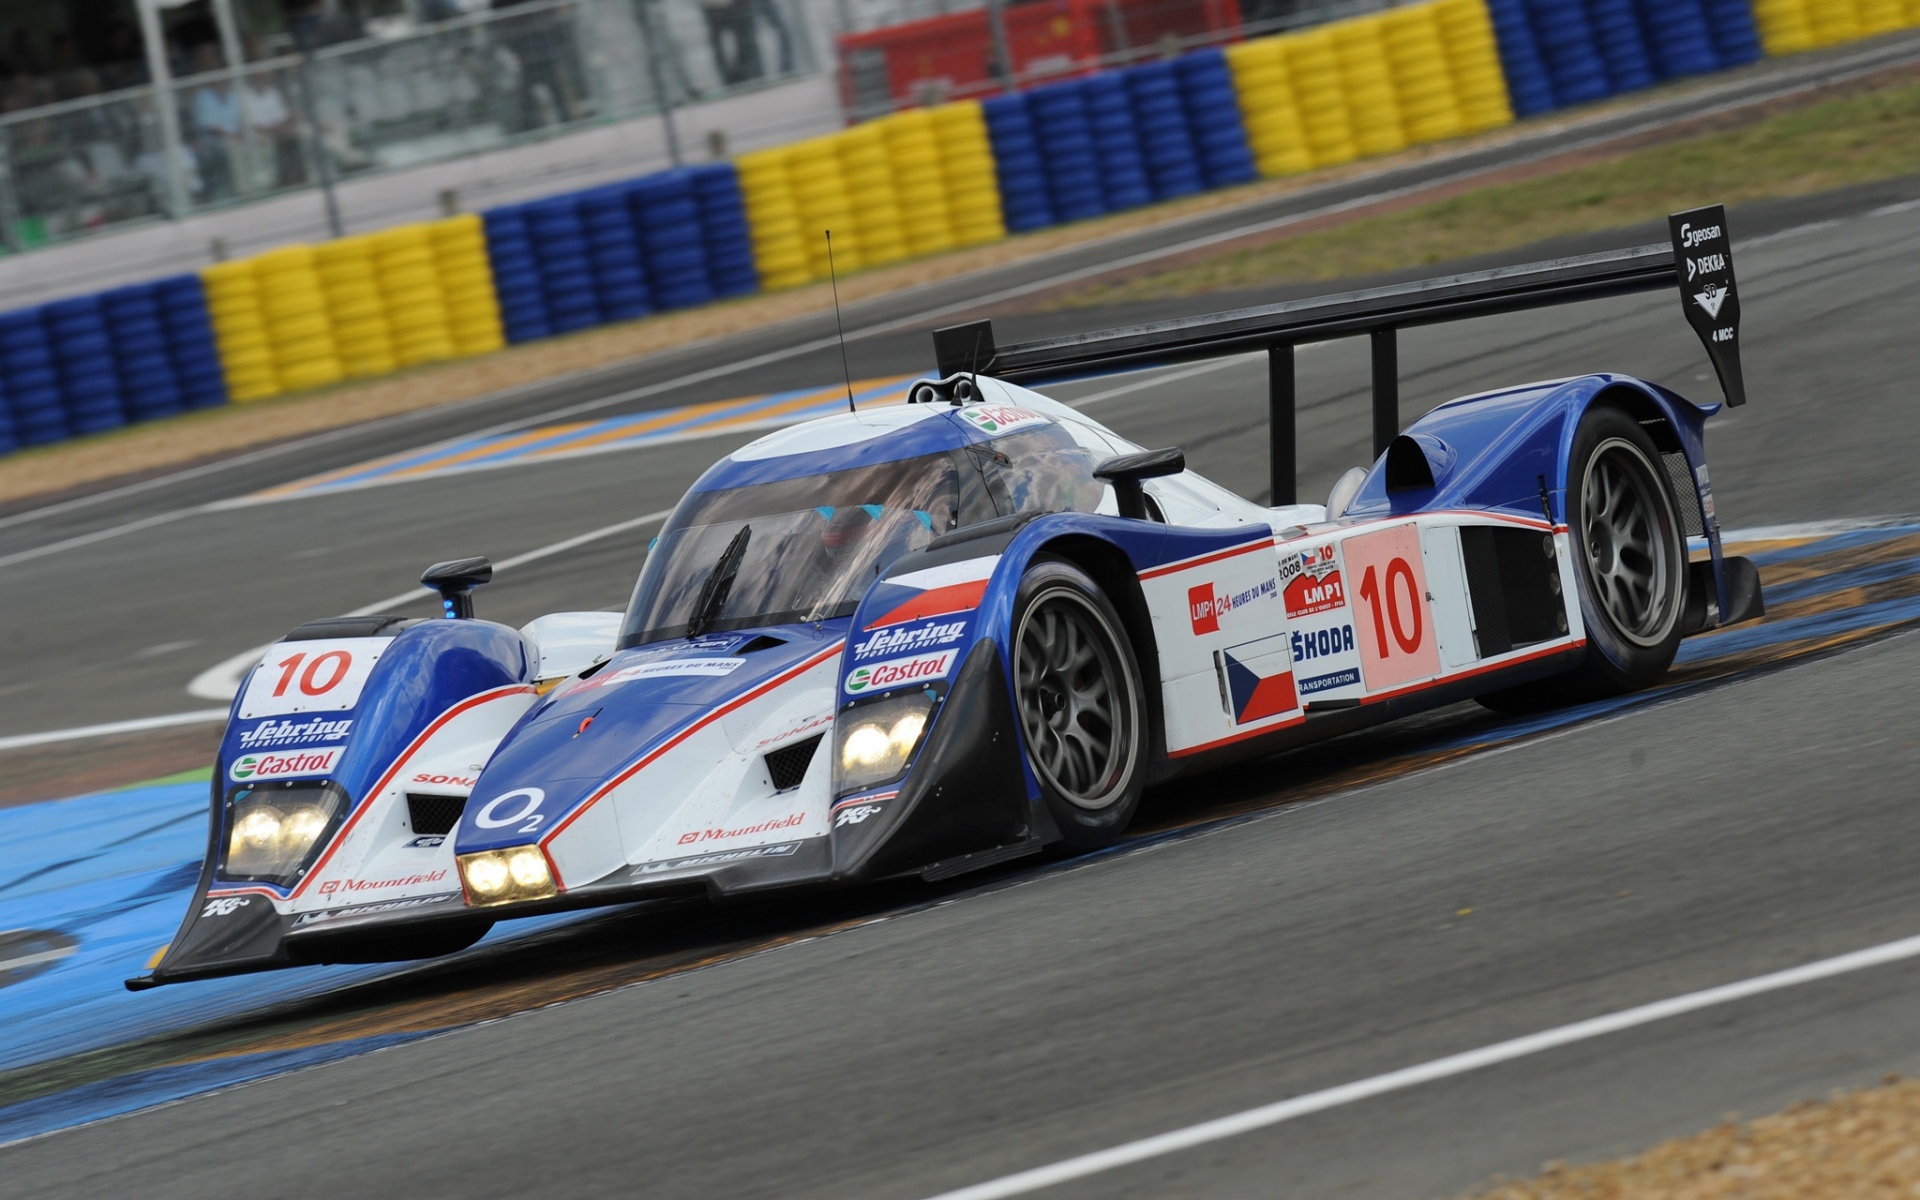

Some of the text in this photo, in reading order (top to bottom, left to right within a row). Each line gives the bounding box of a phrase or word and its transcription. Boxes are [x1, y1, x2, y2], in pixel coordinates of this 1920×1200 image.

[1697, 253, 1725, 275] DEKRA
[1712, 327, 1734, 342] 4 MCC
[1318, 545, 1334, 561] 10
[1192, 578, 1276, 621] LMP1 24 HEURES DU MANS
[1303, 582, 1341, 605] LMP1
[1359, 557, 1423, 660] 10
[854, 621, 967, 655] Sebring
[1290, 624, 1354, 663] ŠKODA
[272, 650, 353, 698] 10
[641, 664, 685, 674] HEURES
[870, 654, 948, 686] Castrol
[240, 717, 354, 742] Sebring
[256, 751, 335, 775] Castrol
[700, 812, 806, 841] Mountfield
[676, 845, 793, 867] MICHELIN
[341, 869, 448, 892] Mountfield
